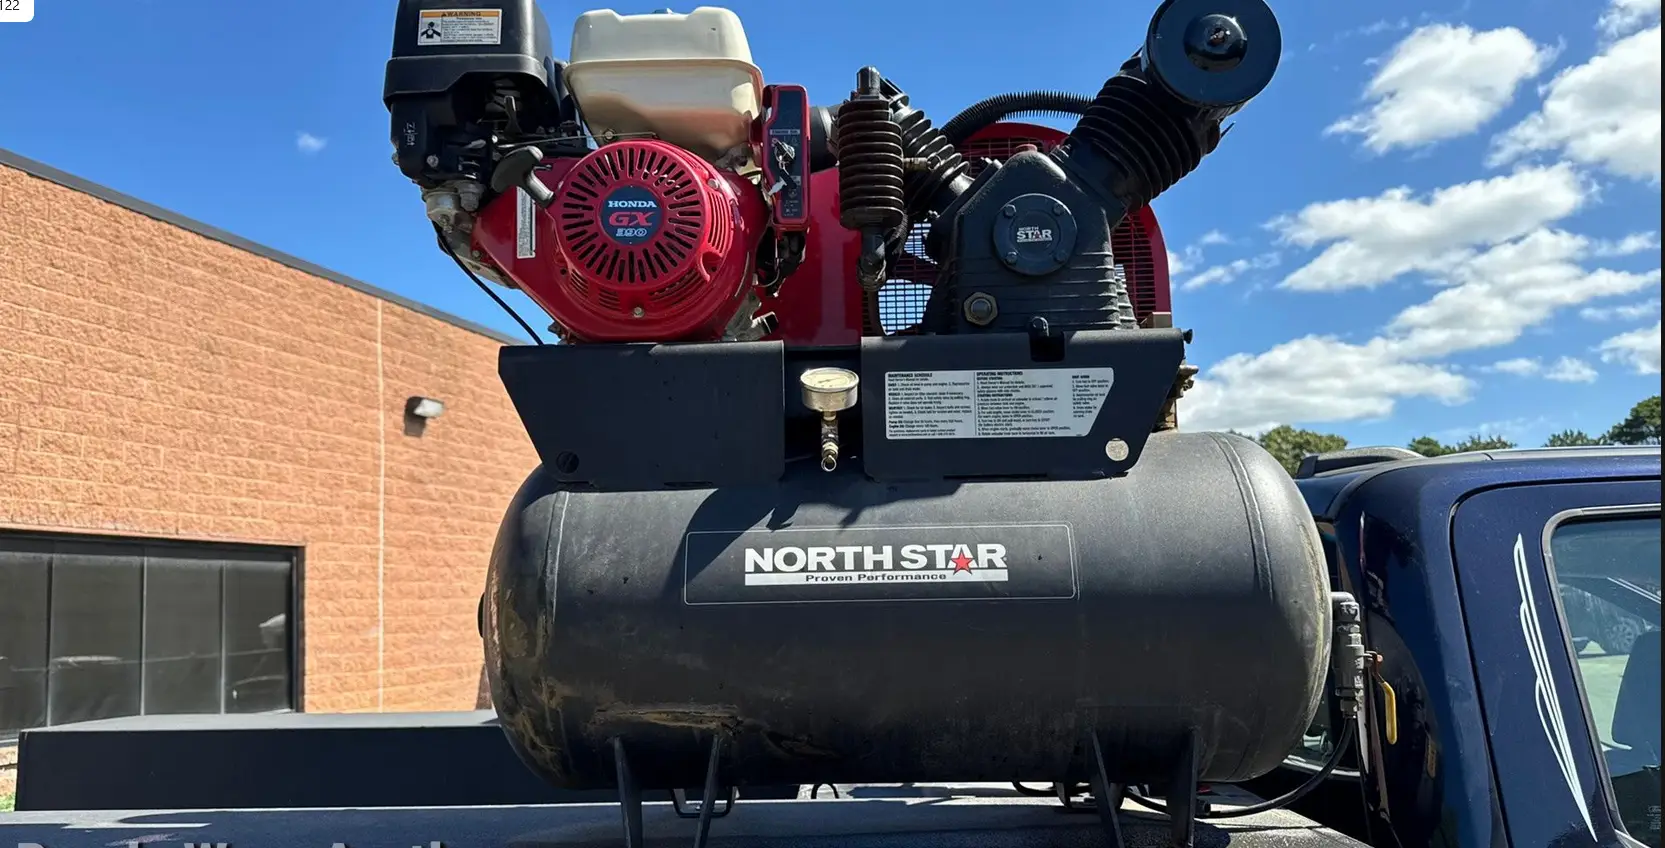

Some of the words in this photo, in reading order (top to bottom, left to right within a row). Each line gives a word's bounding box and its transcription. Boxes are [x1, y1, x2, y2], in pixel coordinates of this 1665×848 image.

[608, 200, 657, 208] HONDA
[609, 211, 655, 227] GX
[1017, 229, 1052, 240] STAR
[745, 545, 893, 573] NORTH
[900, 543, 1007, 571] STAR
[805, 573, 853, 583] Proven
[857, 572, 947, 582] Performance
